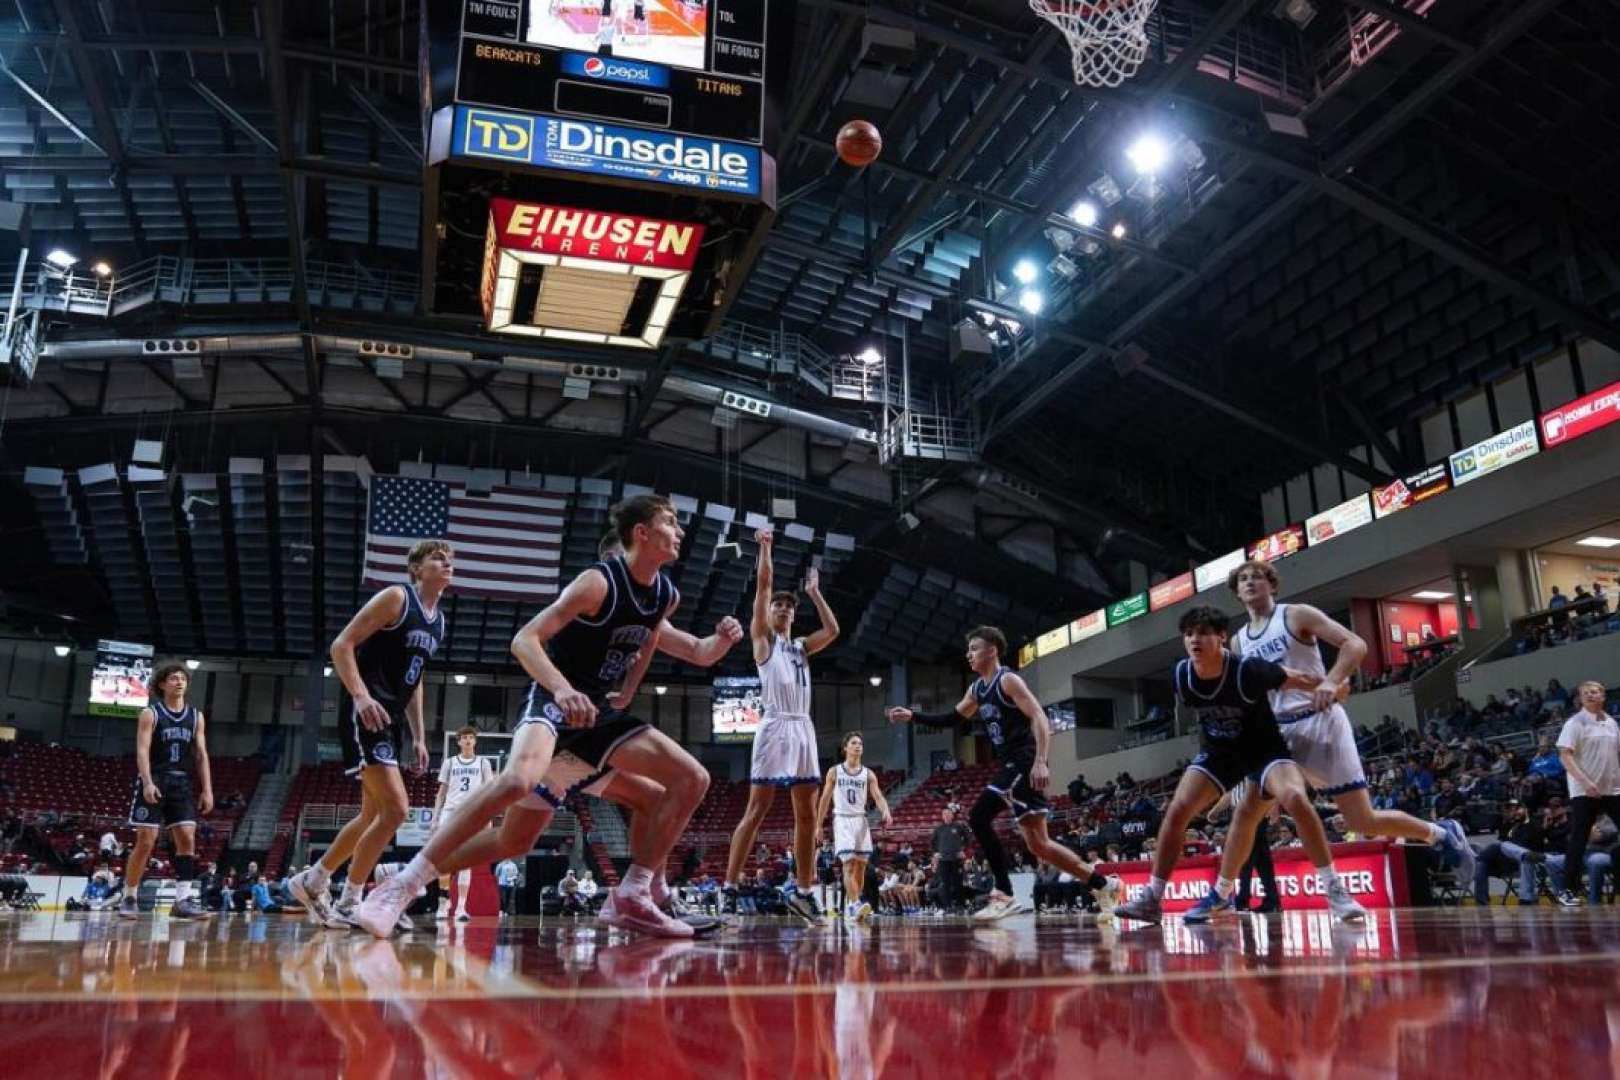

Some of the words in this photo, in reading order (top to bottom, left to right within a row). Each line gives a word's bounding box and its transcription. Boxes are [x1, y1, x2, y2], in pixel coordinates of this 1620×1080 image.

[469, 3, 483, 14] TM
[486, 6, 517, 19] FOULS
[475, 44, 542, 66] BEARCATS
[731, 44, 760, 60] FOULS
[606, 63, 650, 82] pepsi
[696, 78, 743, 97] TITANS
[472, 119, 530, 152] TD
[560, 121, 749, 175] Dinsdale
[667, 169, 702, 185] Jeep
[505, 203, 695, 256] EIHUSEN
[530, 235, 656, 263] ARENA
[1477, 426, 1534, 458] Dinsdale
[460, 776, 471, 792] 3
[1126, 880, 1211, 901] HETLAND
[1303, 870, 1376, 896] CETER
